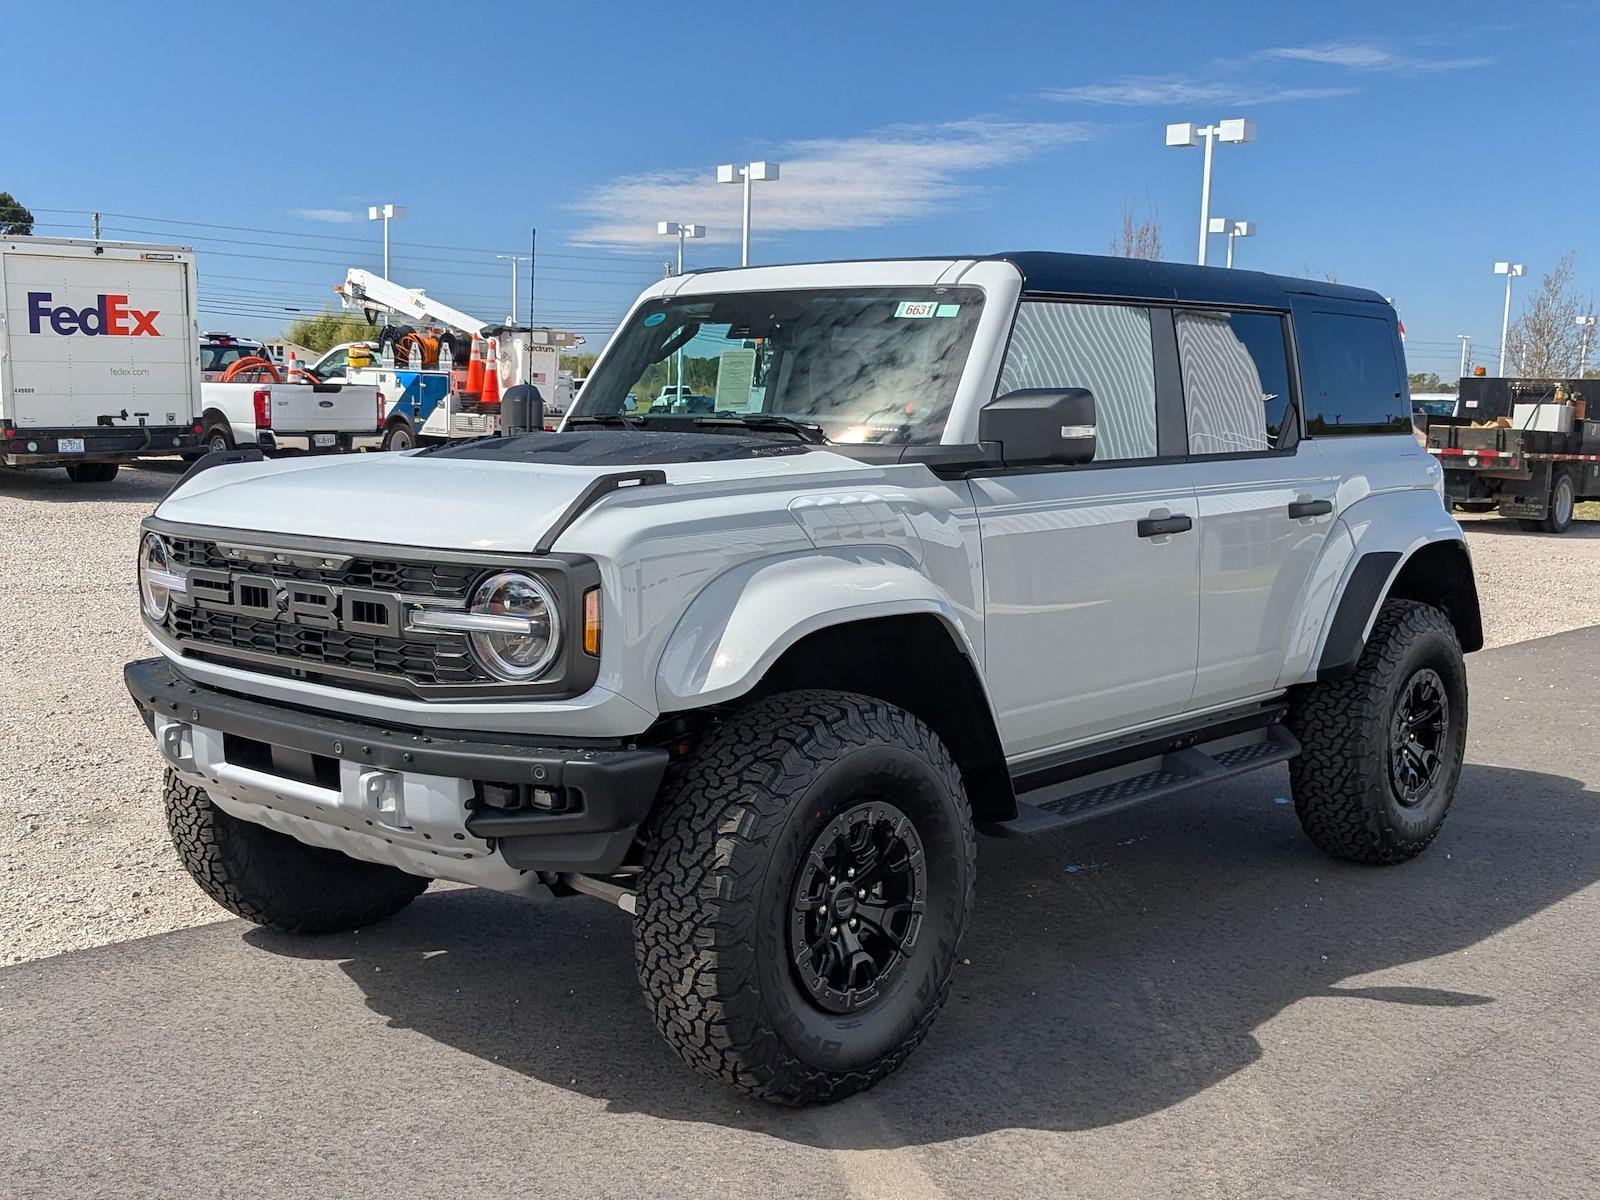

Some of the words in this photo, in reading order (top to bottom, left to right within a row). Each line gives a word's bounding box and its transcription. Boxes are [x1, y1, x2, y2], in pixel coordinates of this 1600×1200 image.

[27, 291, 161, 336] FedEx
[905, 303, 933, 316] 6631
[523, 343, 555, 352] Spectrum
[110, 368, 149, 376] fedex.com
[185, 567, 401, 638] FORD
